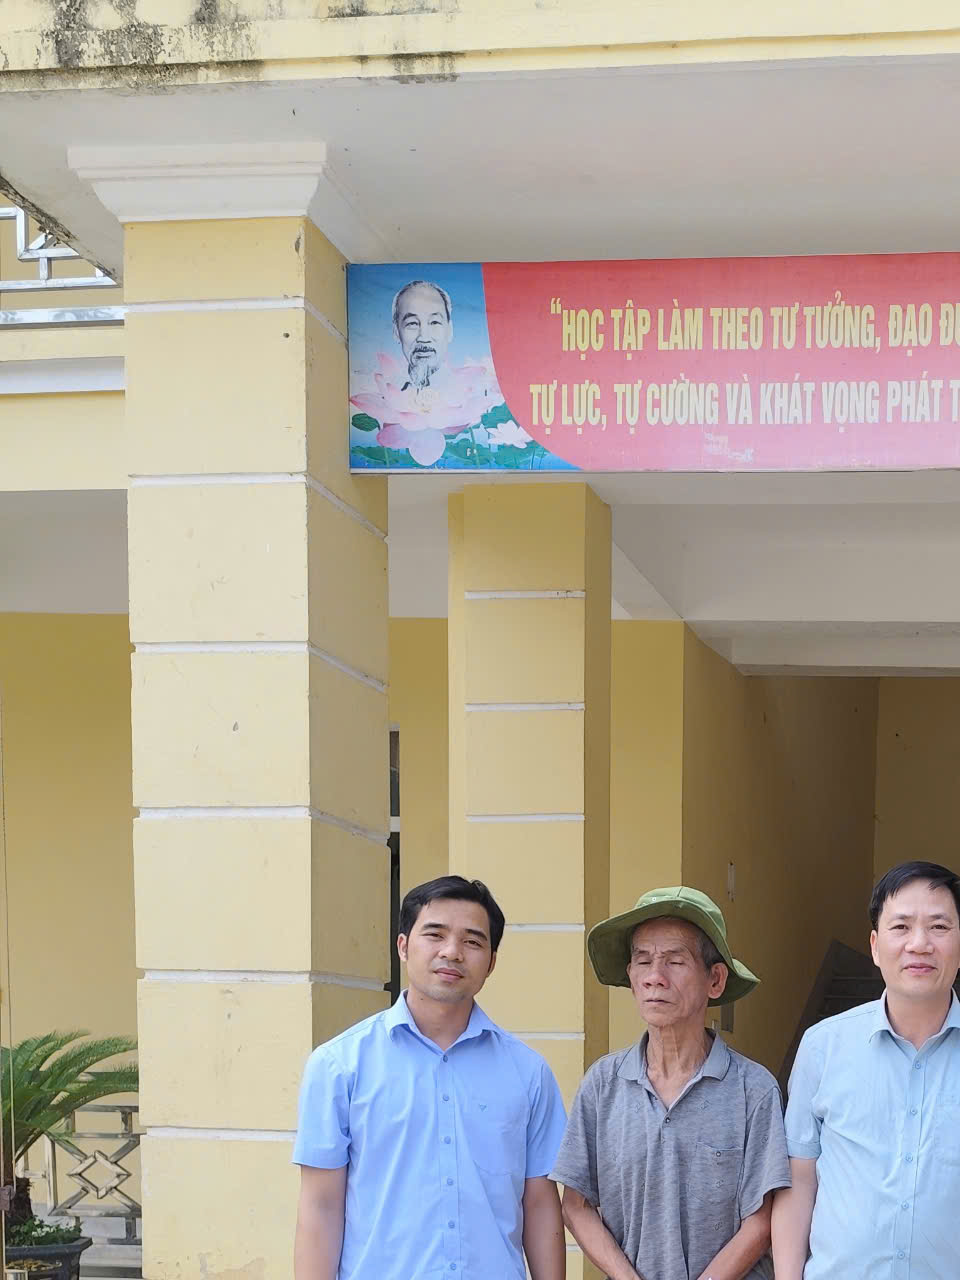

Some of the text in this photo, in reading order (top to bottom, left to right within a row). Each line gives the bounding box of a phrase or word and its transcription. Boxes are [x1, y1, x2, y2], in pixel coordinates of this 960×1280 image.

[550, 298, 604, 360] “HỌC
[611, 299, 650, 360] TẬP
[658, 299, 703, 350] LÀM
[710, 307, 763, 350] THEO
[771, 302, 799, 348] TƯ
[804, 290, 880, 354] TƯỞNG,
[888, 304, 932, 356] ĐẠO
[530, 380, 557, 434] TỰ
[562, 380, 607, 434] LỰC,
[614, 380, 641, 434] TỰ
[646, 372, 719, 425] CƯỜNG
[725, 374, 753, 424] VÀ
[759, 373, 815, 423] KHÁT
[821, 381, 880, 433] VỌNG
[886, 371, 943, 422] PHÁT
